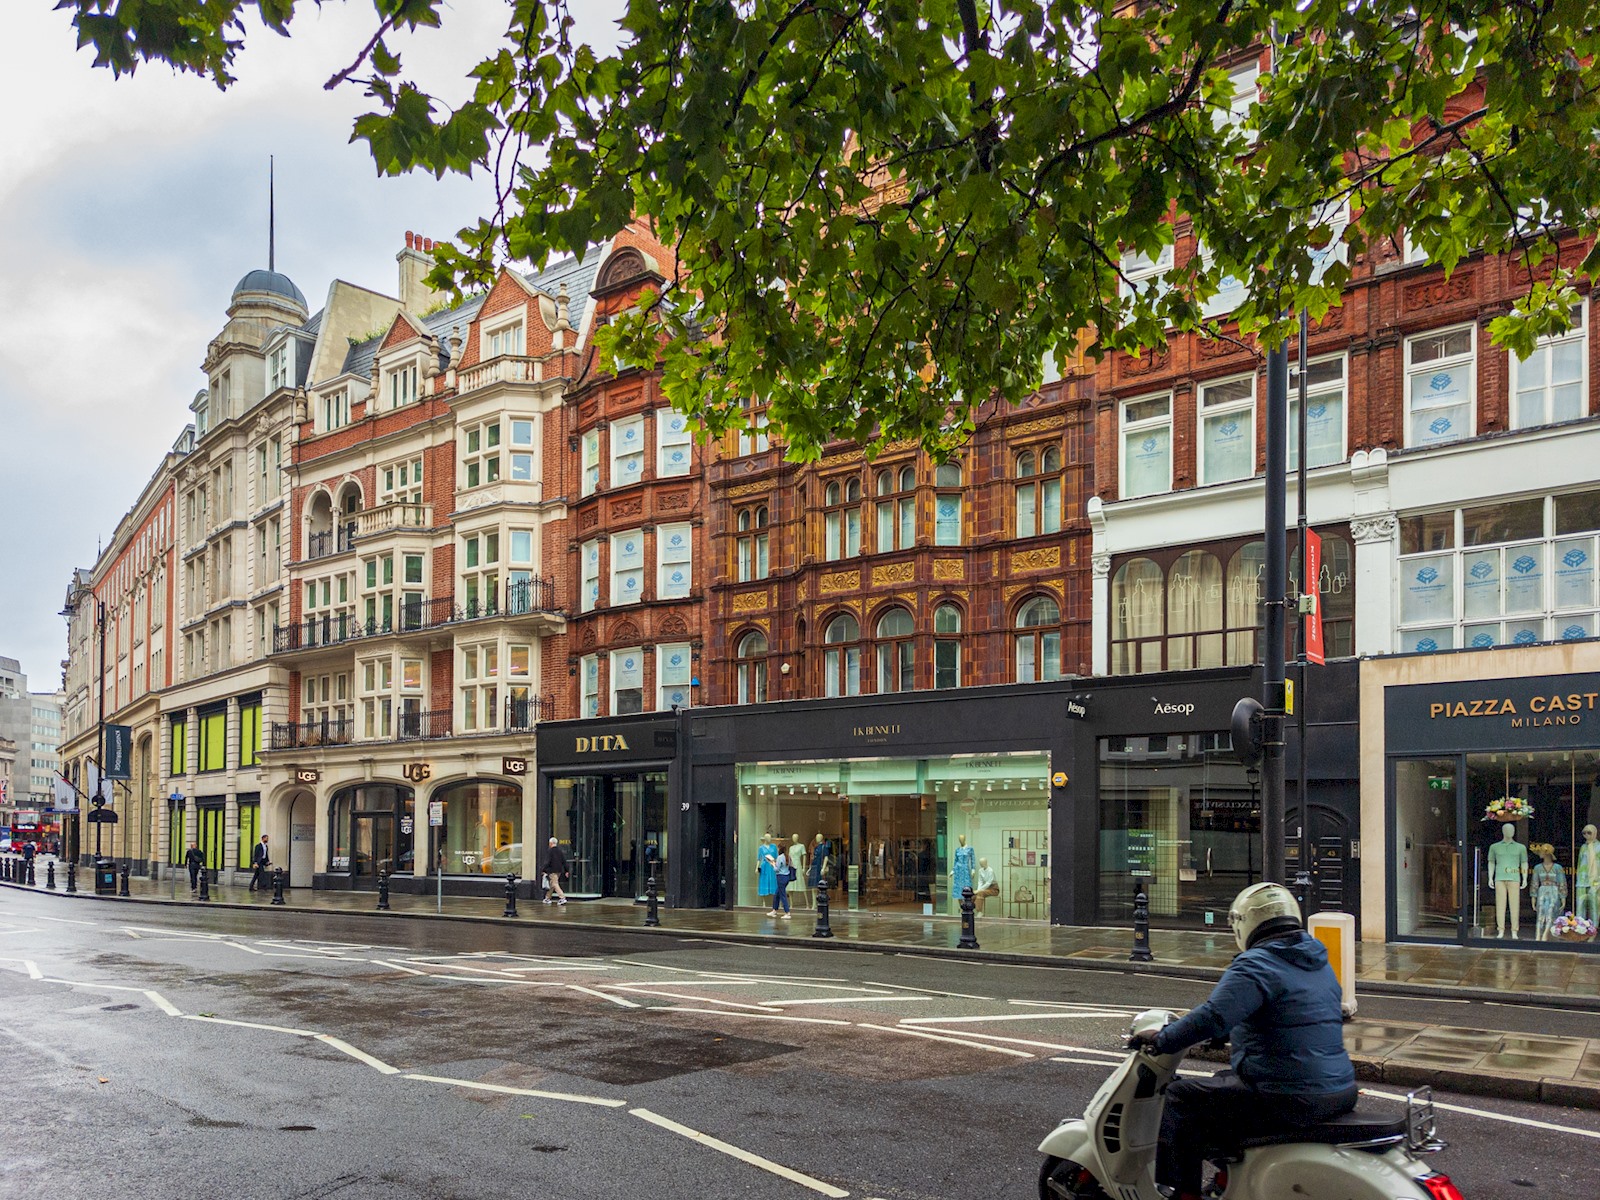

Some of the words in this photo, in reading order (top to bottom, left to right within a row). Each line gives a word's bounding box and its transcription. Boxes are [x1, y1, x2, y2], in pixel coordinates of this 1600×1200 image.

[1154, 702, 1195, 716] Aēsop
[1430, 698, 1517, 718] PIAZZA
[1511, 714, 1581, 728] MILANO
[575, 734, 630, 753] DITA
[402, 763, 431, 783] UGG
[506, 760, 525, 773] UGG
[297, 771, 317, 782] UGG
[680, 802, 690, 812] 39
[400, 826, 413, 835] UGG
[462, 855, 476, 865] UGG
